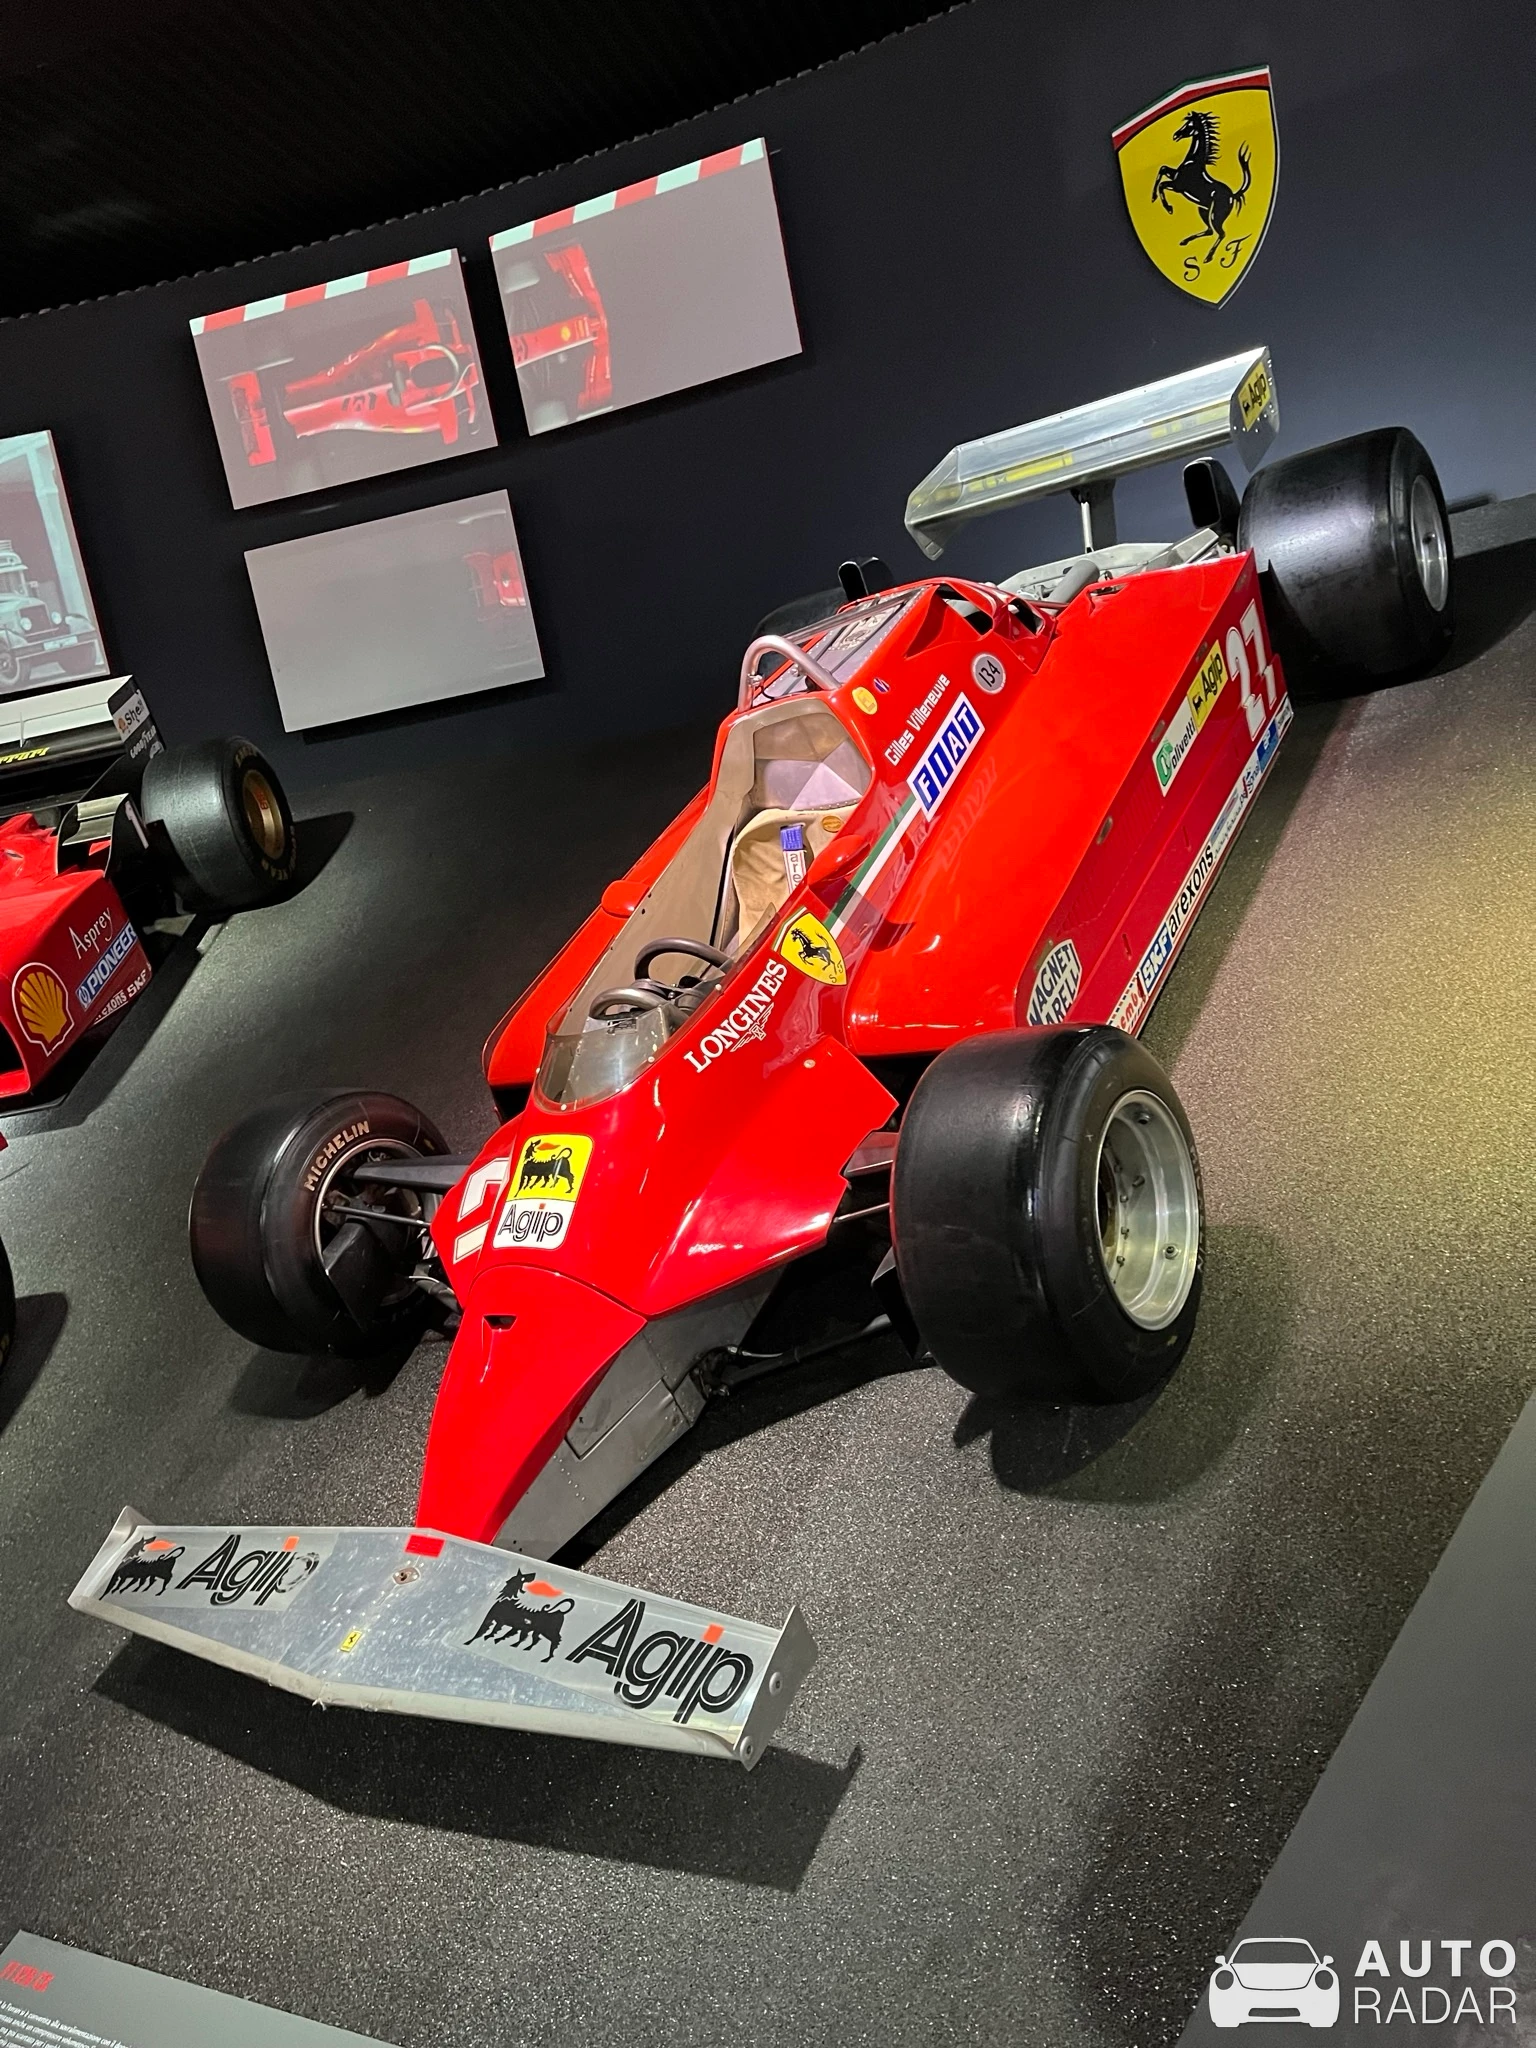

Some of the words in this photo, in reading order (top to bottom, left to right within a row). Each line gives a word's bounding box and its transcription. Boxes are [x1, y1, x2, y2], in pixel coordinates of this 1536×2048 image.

[1183, 256, 1201, 282] S
[1248, 372, 1267, 409] Agip
[978, 660, 1001, 687] 134
[1200, 652, 1224, 702] Agip
[884, 729, 915, 767] Gilles
[906, 673, 951, 732] Villeneuve
[1171, 718, 1196, 770] olivetti
[914, 703, 979, 811] FIAT
[1168, 844, 1214, 938] arexons
[68, 907, 114, 960] Asprey
[86, 922, 137, 996] PIONEER
[1142, 927, 1168, 989] SKF
[126, 968, 146, 998] SKF
[683, 958, 788, 1073] LONGINES
[303, 1120, 370, 1191] MICHELIN
[498, 1202, 565, 1243] Agip
[175, 1534, 321, 1607] Agip
[564, 1598, 755, 1725] Agip
